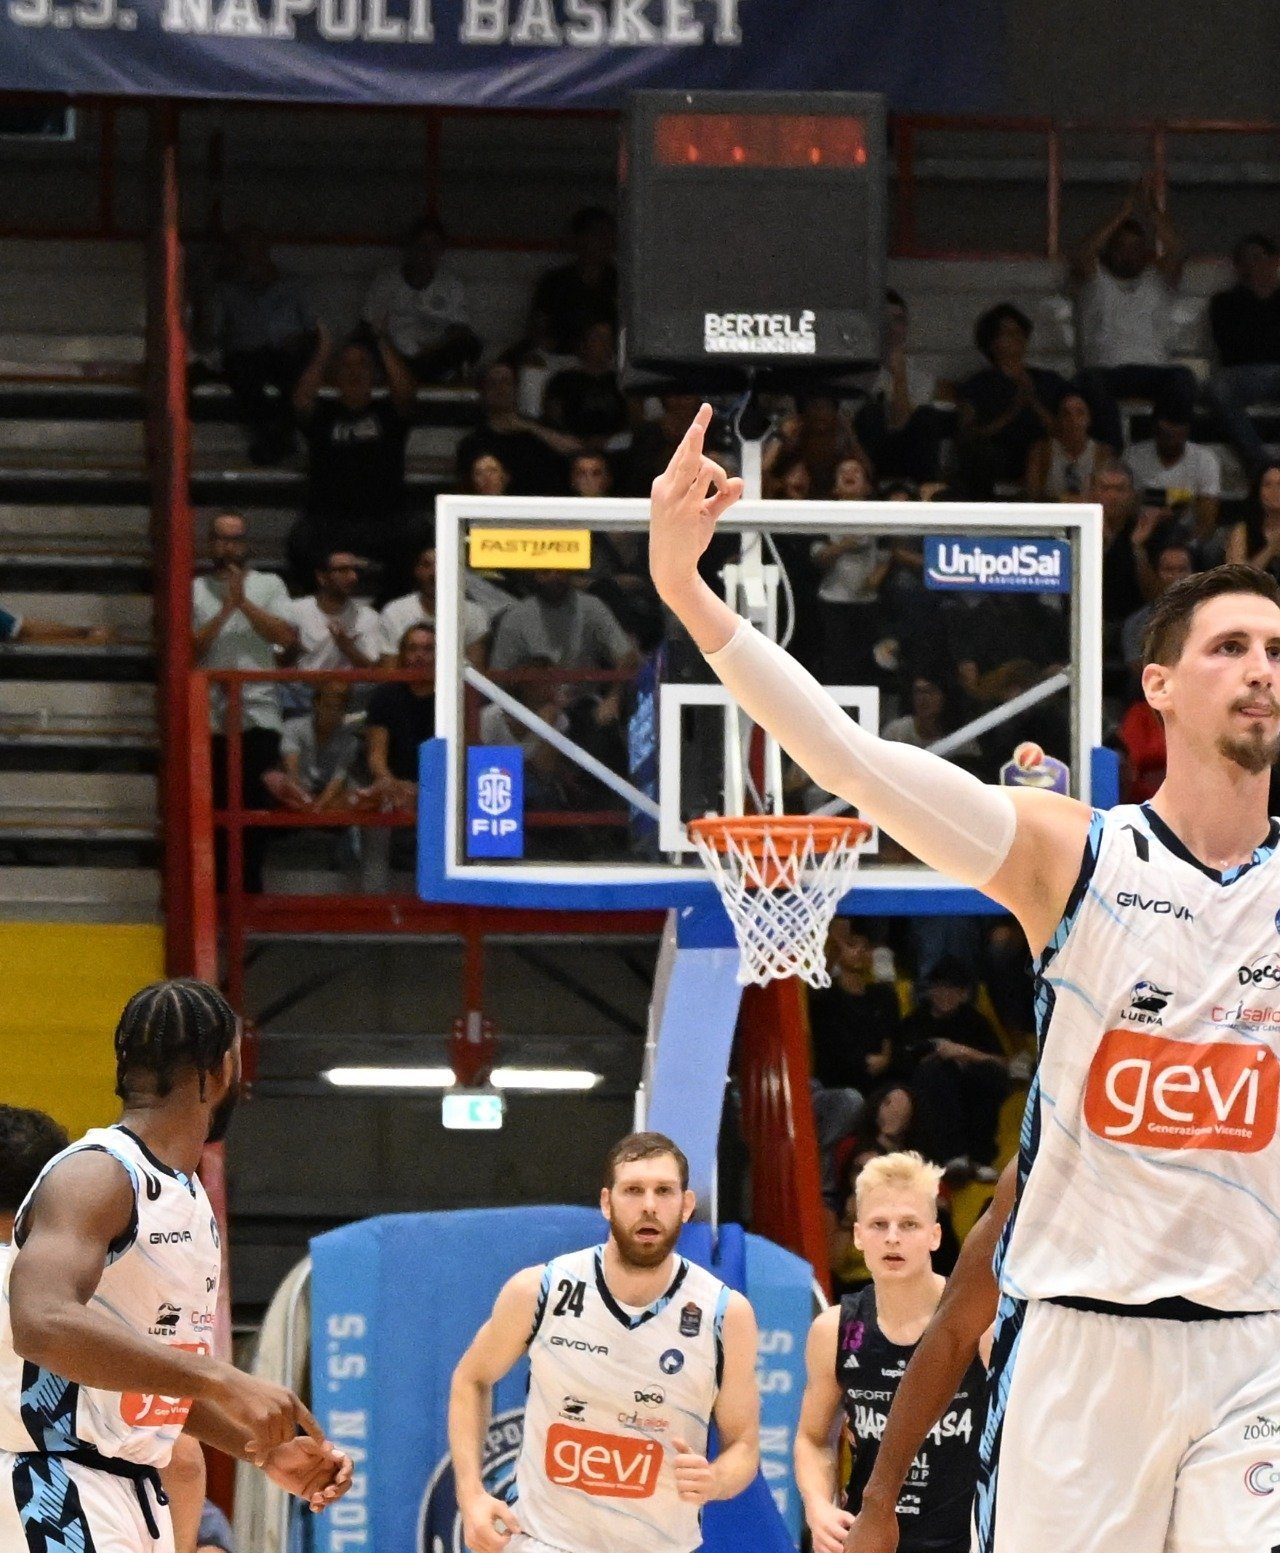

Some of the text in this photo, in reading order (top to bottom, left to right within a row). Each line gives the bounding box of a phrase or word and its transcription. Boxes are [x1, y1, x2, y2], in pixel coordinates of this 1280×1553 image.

[160, 0, 434, 43] NAPOLI
[459, 0, 742, 46] BASKET
[938, 543, 1061, 584] UnipolSai
[472, 819, 517, 836] FIP
[1105, 1050, 1267, 1137] gevi
[1147, 1122, 1253, 1139] Generazione Vicente
[149, 1230, 193, 1245] GIVOVA
[553, 1279, 587, 1318] 24
[328, 1314, 367, 1392] S.S.
[550, 1335, 609, 1356] GIVOVA
[553, 1440, 655, 1485] gevi
